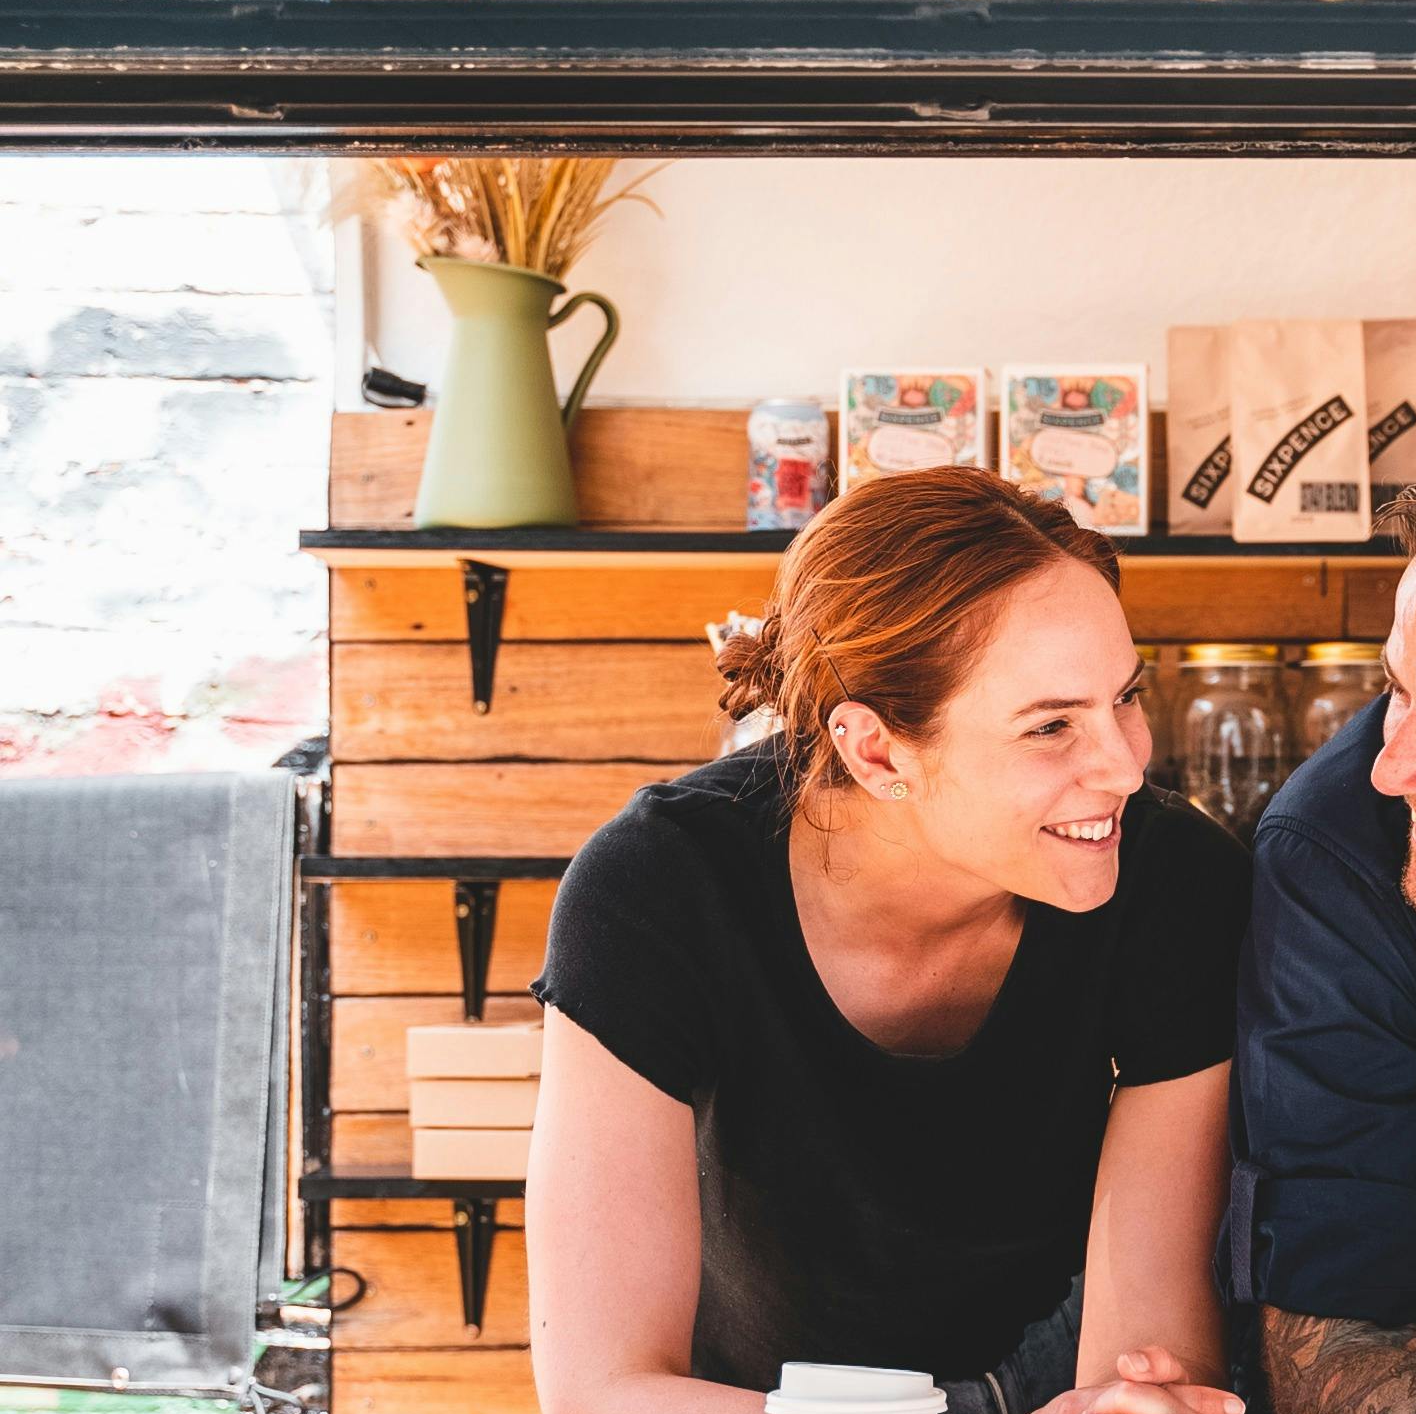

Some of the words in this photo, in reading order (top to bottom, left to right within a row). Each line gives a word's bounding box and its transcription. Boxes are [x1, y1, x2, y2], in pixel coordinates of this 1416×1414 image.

[1253, 400, 1349, 497] SIXPENCE
[1369, 406, 1412, 455] NCE
[1189, 443, 1230, 501] SIXP
